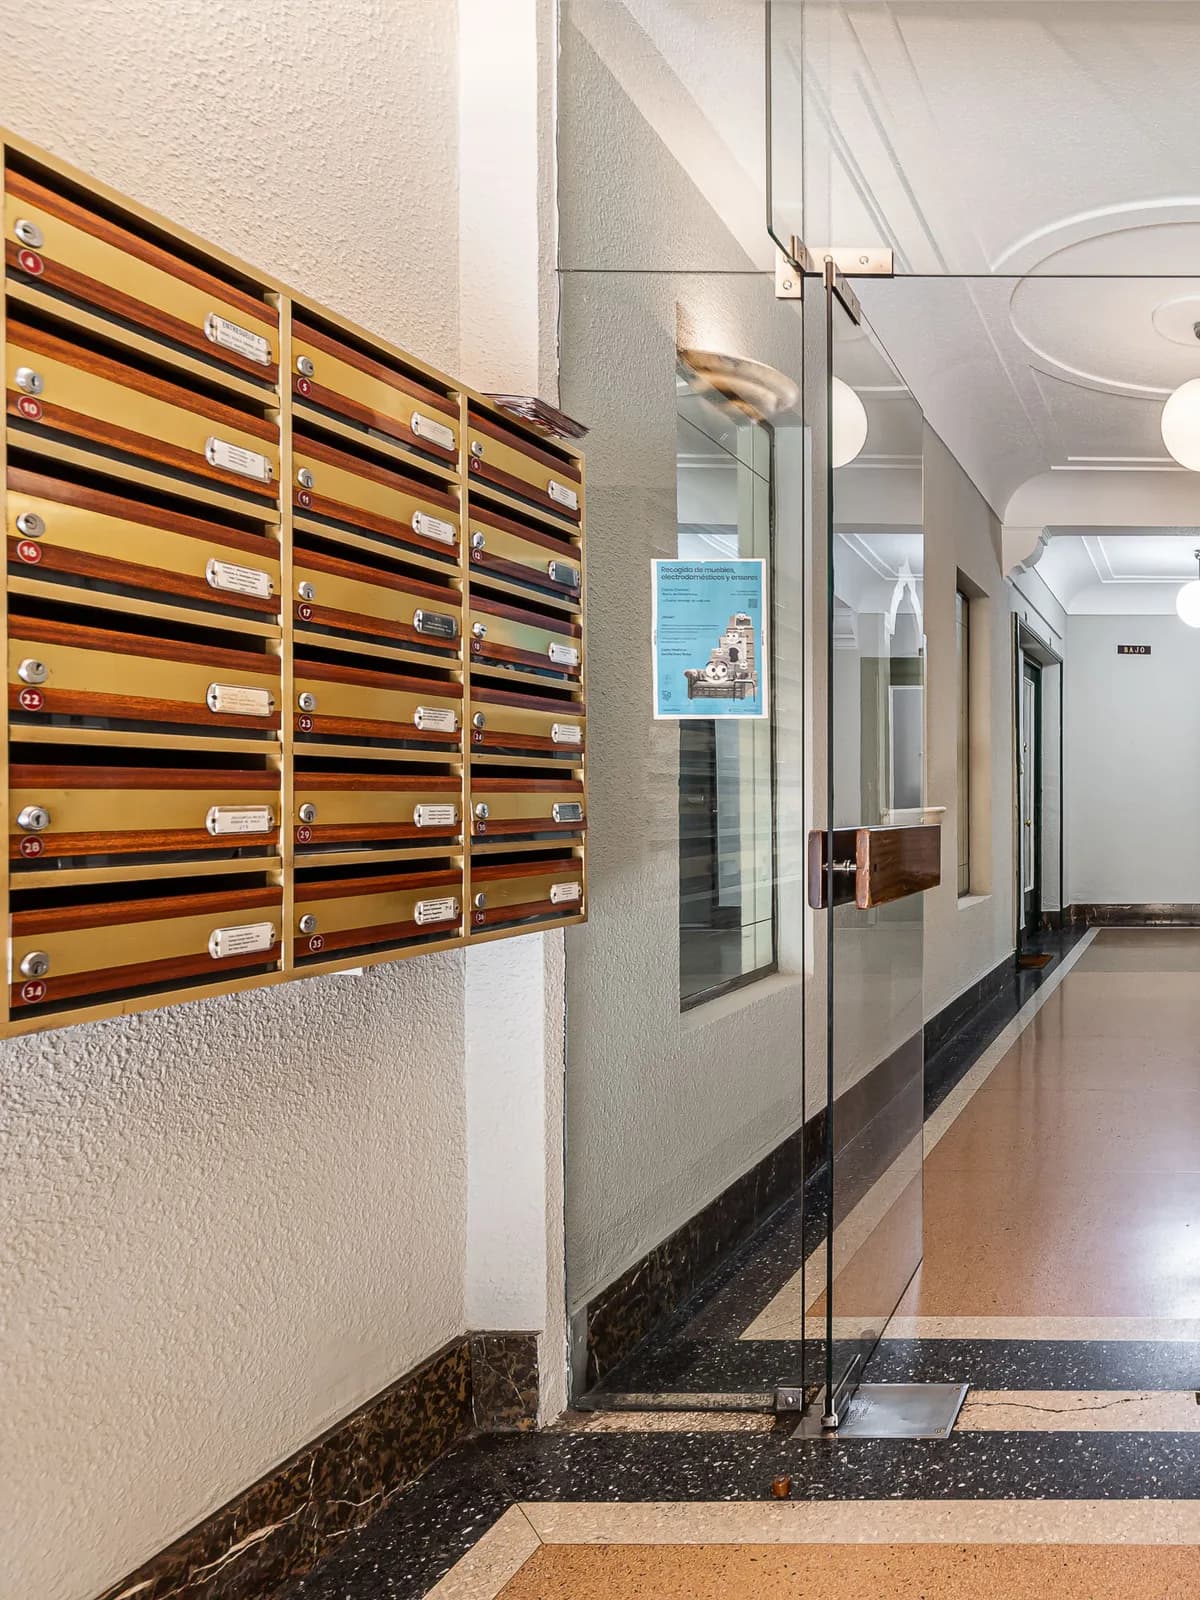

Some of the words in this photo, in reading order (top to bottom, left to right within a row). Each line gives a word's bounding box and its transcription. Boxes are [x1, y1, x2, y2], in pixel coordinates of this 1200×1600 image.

[23, 402, 38, 414] 10
[302, 495, 309, 504] 11
[22, 545, 37, 557] 16
[661, 566, 693, 574] Recogida
[704, 566, 736, 574] muebles,
[303, 608, 311, 616] 17
[1123, 646, 1145, 654] BAJO
[23, 693, 40, 705] 22
[301, 719, 311, 728] 23
[300, 830, 310, 839] 29
[24, 842, 40, 853] 28
[26, 986, 42, 998] 34
